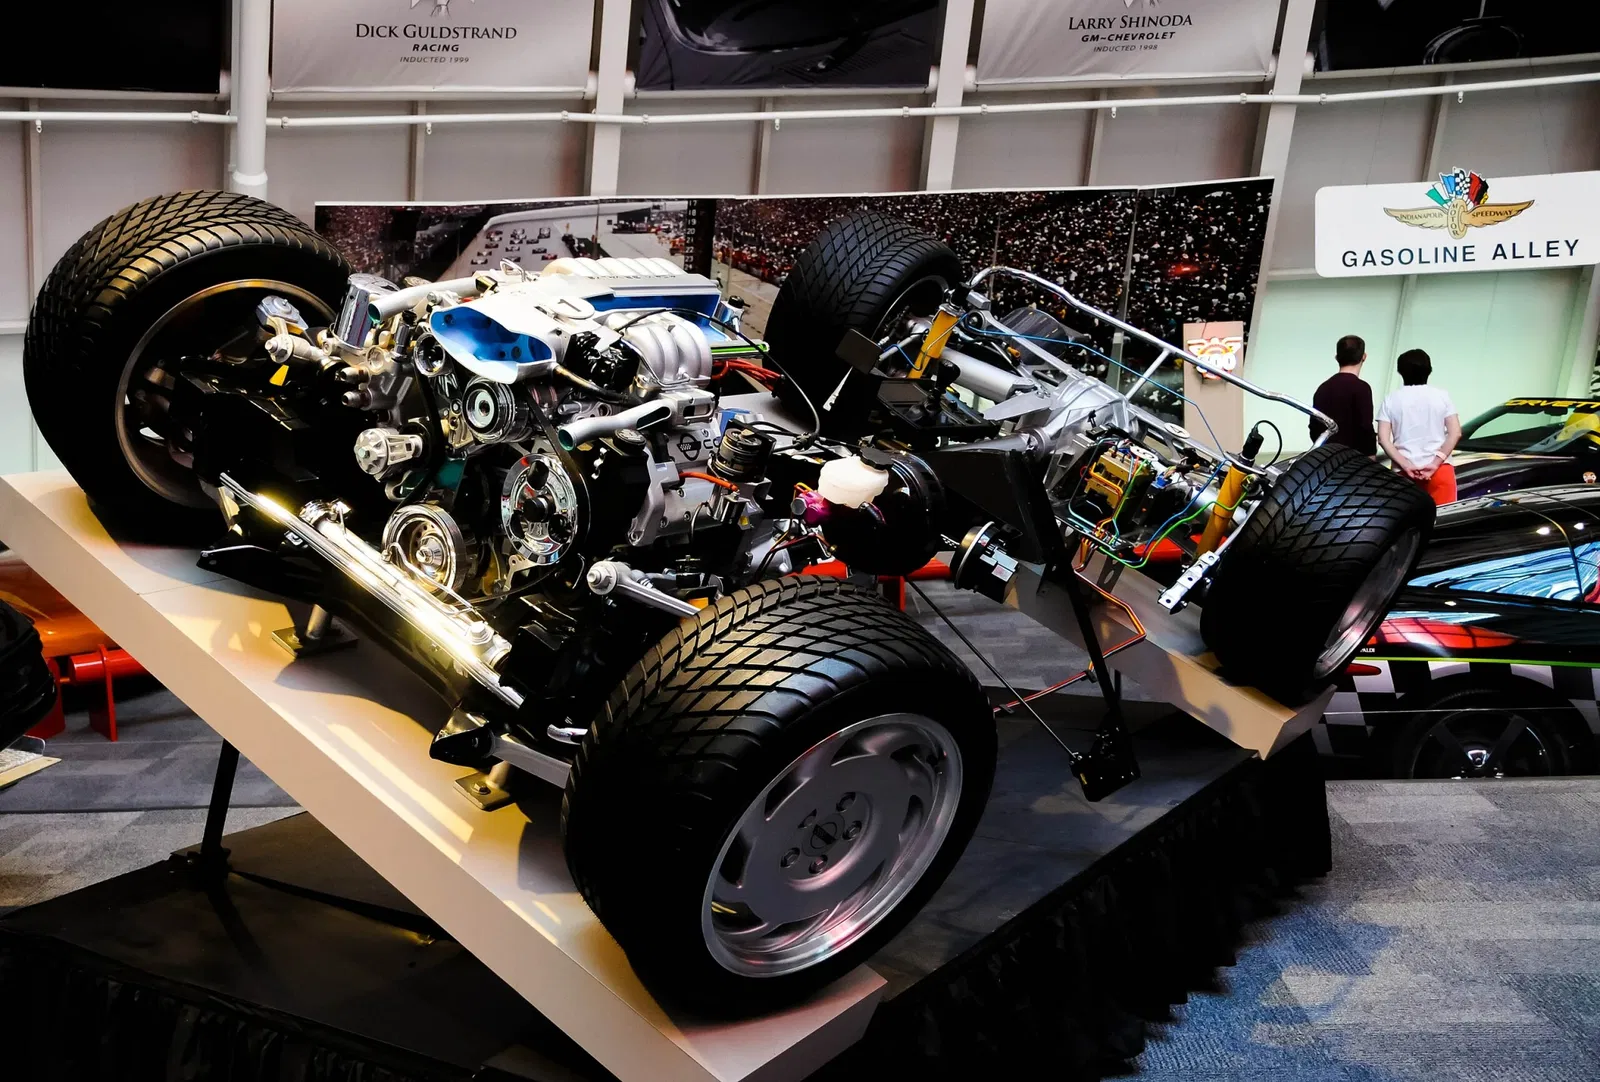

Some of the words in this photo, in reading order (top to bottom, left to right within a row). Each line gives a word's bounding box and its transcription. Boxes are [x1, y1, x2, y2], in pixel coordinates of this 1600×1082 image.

[1068, 16, 1117, 30] LARRY
[1119, 14, 1193, 29] SHINODA
[355, 23, 399, 38] DICK
[402, 23, 518, 39] GULDSTRAND
[411, 43, 460, 52] RACING
[1093, 44, 1137, 53] INDUCTED
[399, 56, 446, 64] INDUCTED
[449, 56, 470, 64] 1999
[1400, 212, 1443, 221] INDIANAPOLIS
[1471, 209, 1514, 219] SPEEDWAY
[1450, 203, 1460, 236] MOTOR
[1341, 245, 1477, 268] GASOLINE
[1491, 239, 1580, 261] ALLEY
